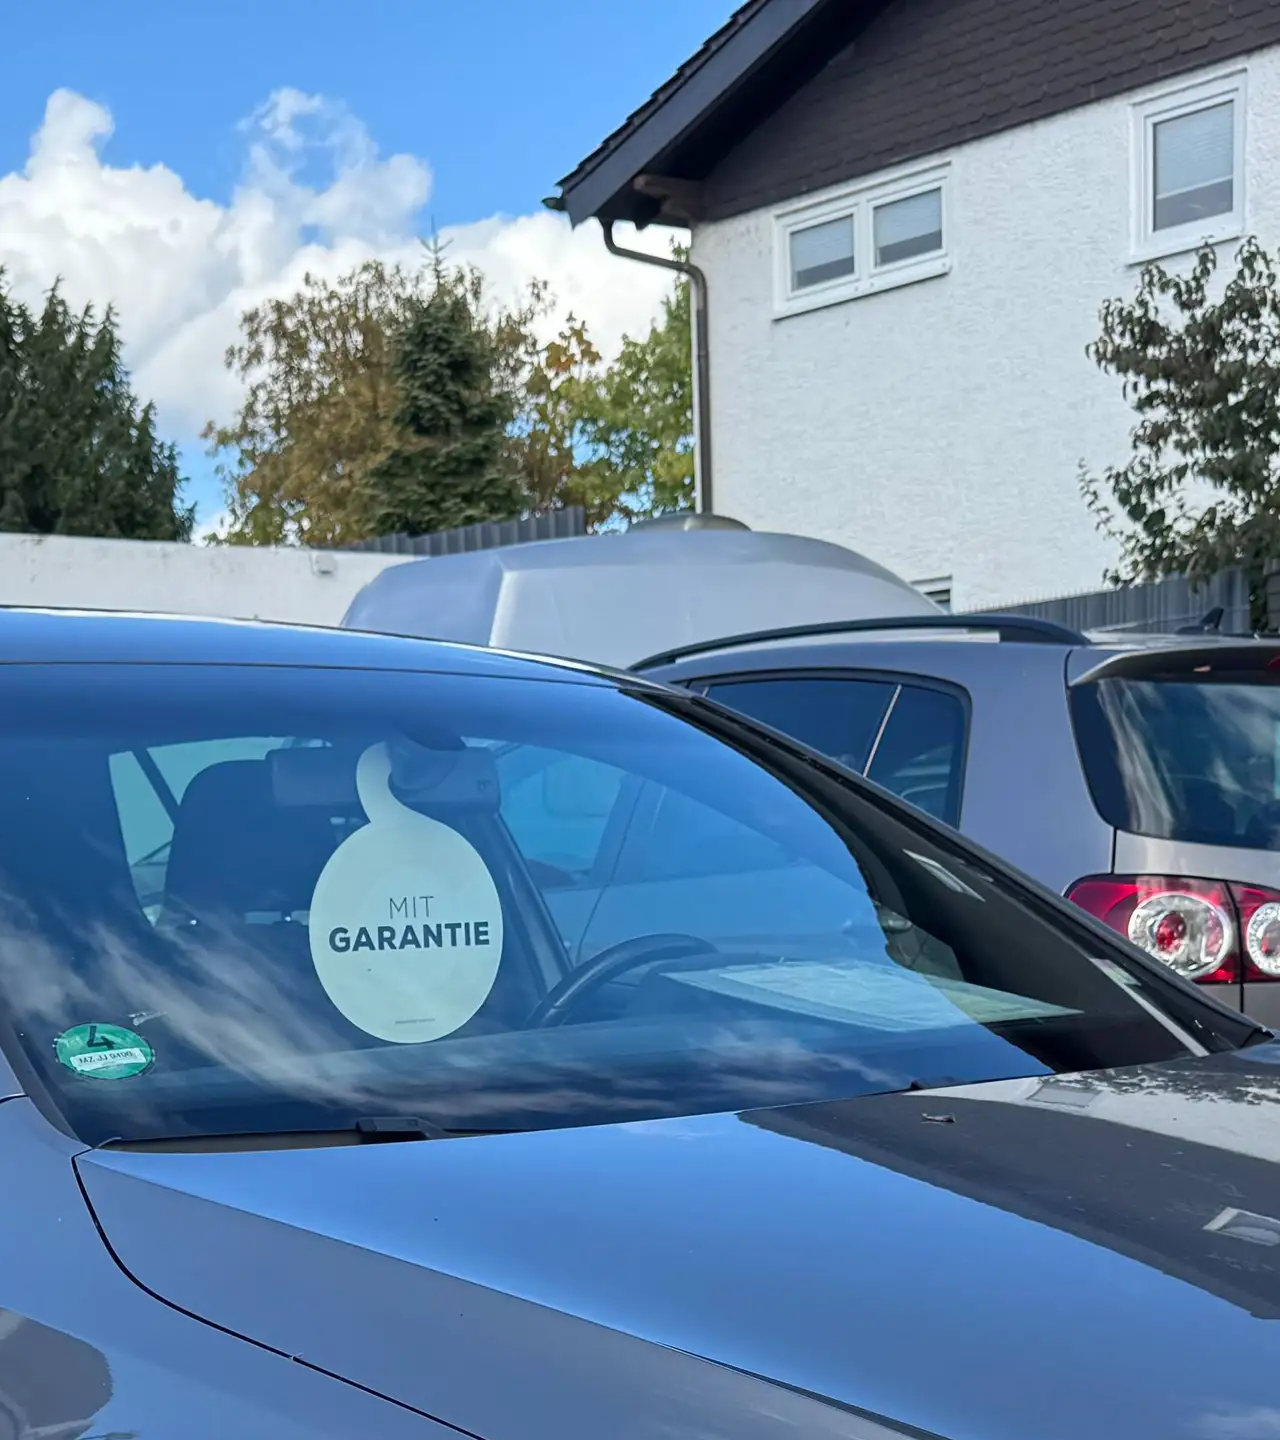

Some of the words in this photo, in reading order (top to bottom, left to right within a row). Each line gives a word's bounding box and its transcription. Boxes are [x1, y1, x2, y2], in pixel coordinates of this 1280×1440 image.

[389, 896, 434, 919] MIT
[329, 921, 490, 953] GARANTIE
[87, 1025, 116, 1050] 4
